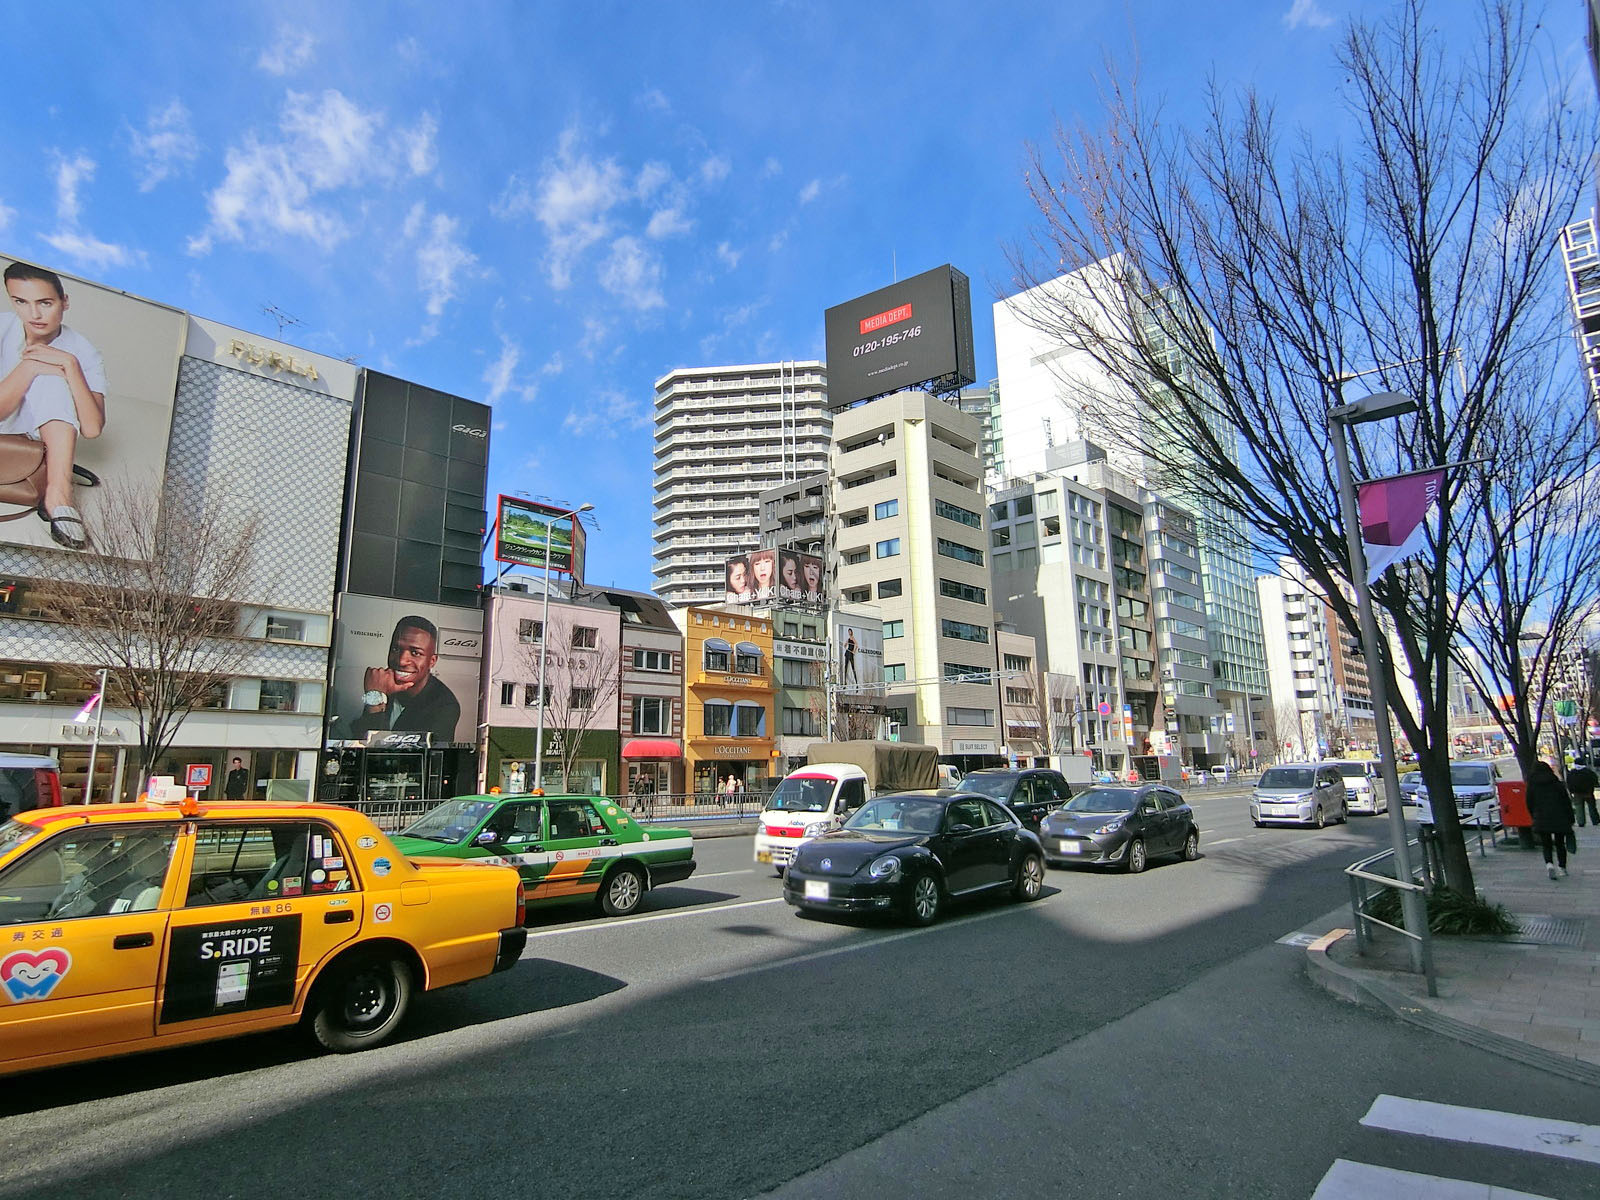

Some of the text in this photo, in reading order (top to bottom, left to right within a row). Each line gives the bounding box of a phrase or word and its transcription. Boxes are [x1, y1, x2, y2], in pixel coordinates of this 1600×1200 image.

[864, 307, 908, 330] MEDIA DEPT.
[853, 325, 922, 357] 0120-195-746
[229, 339, 318, 381] FURLA
[727, 586, 776, 602] Chara+YUKI
[780, 584, 823, 602] Chara+YUKI
[61, 724, 121, 737] FURLA
[275, 903, 292, 913] 86
[201, 935, 272, 960] S.RIDE
